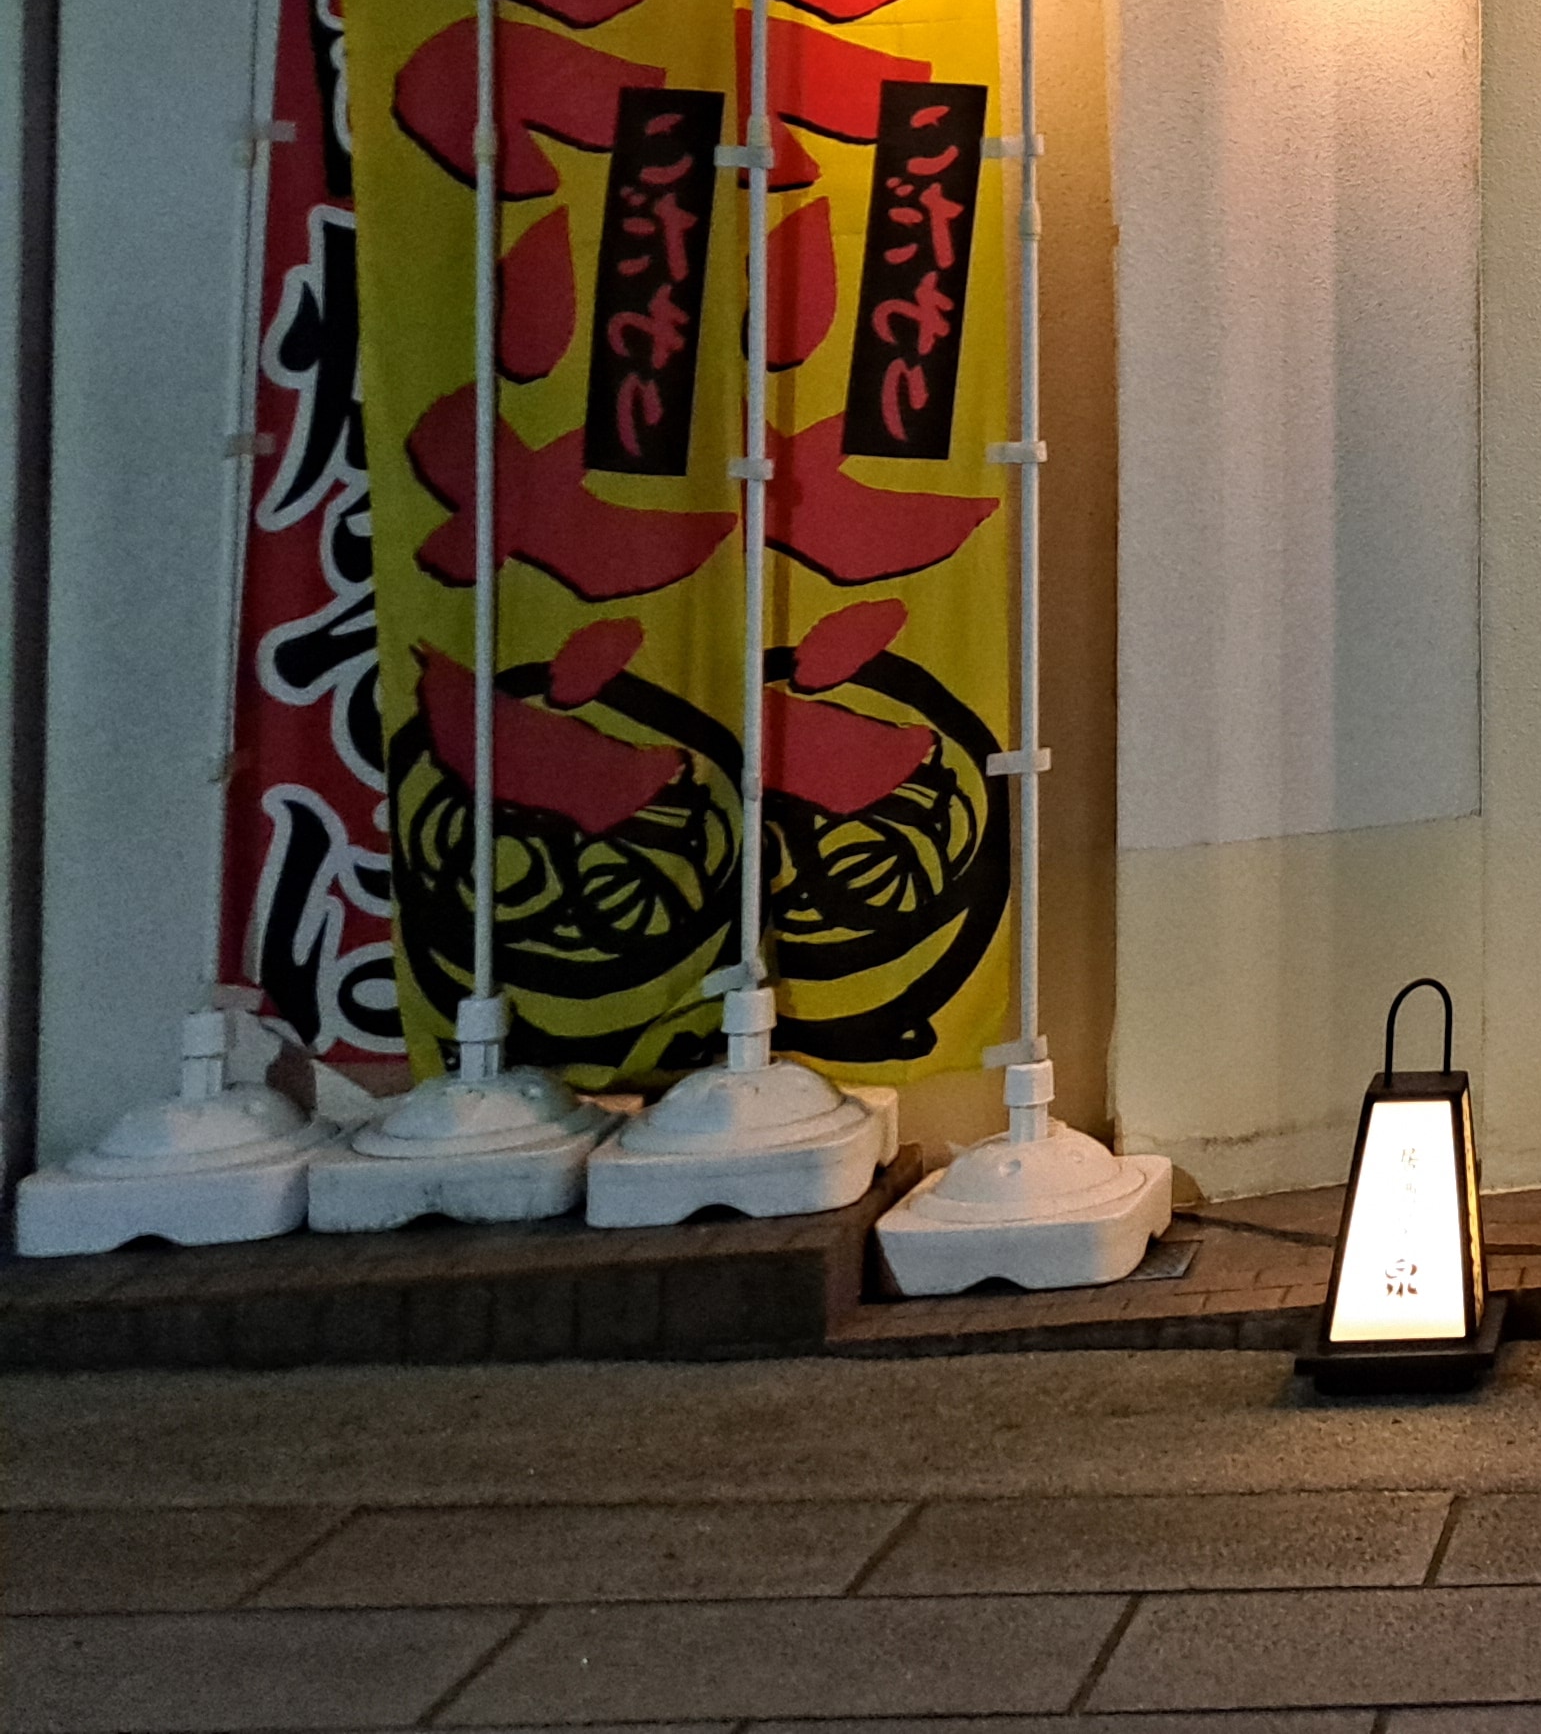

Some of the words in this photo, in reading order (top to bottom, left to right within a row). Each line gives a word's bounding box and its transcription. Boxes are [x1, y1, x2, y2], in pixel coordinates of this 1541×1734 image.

[607, 113, 698, 458] こだわり
[871, 105, 965, 443] こだわり
